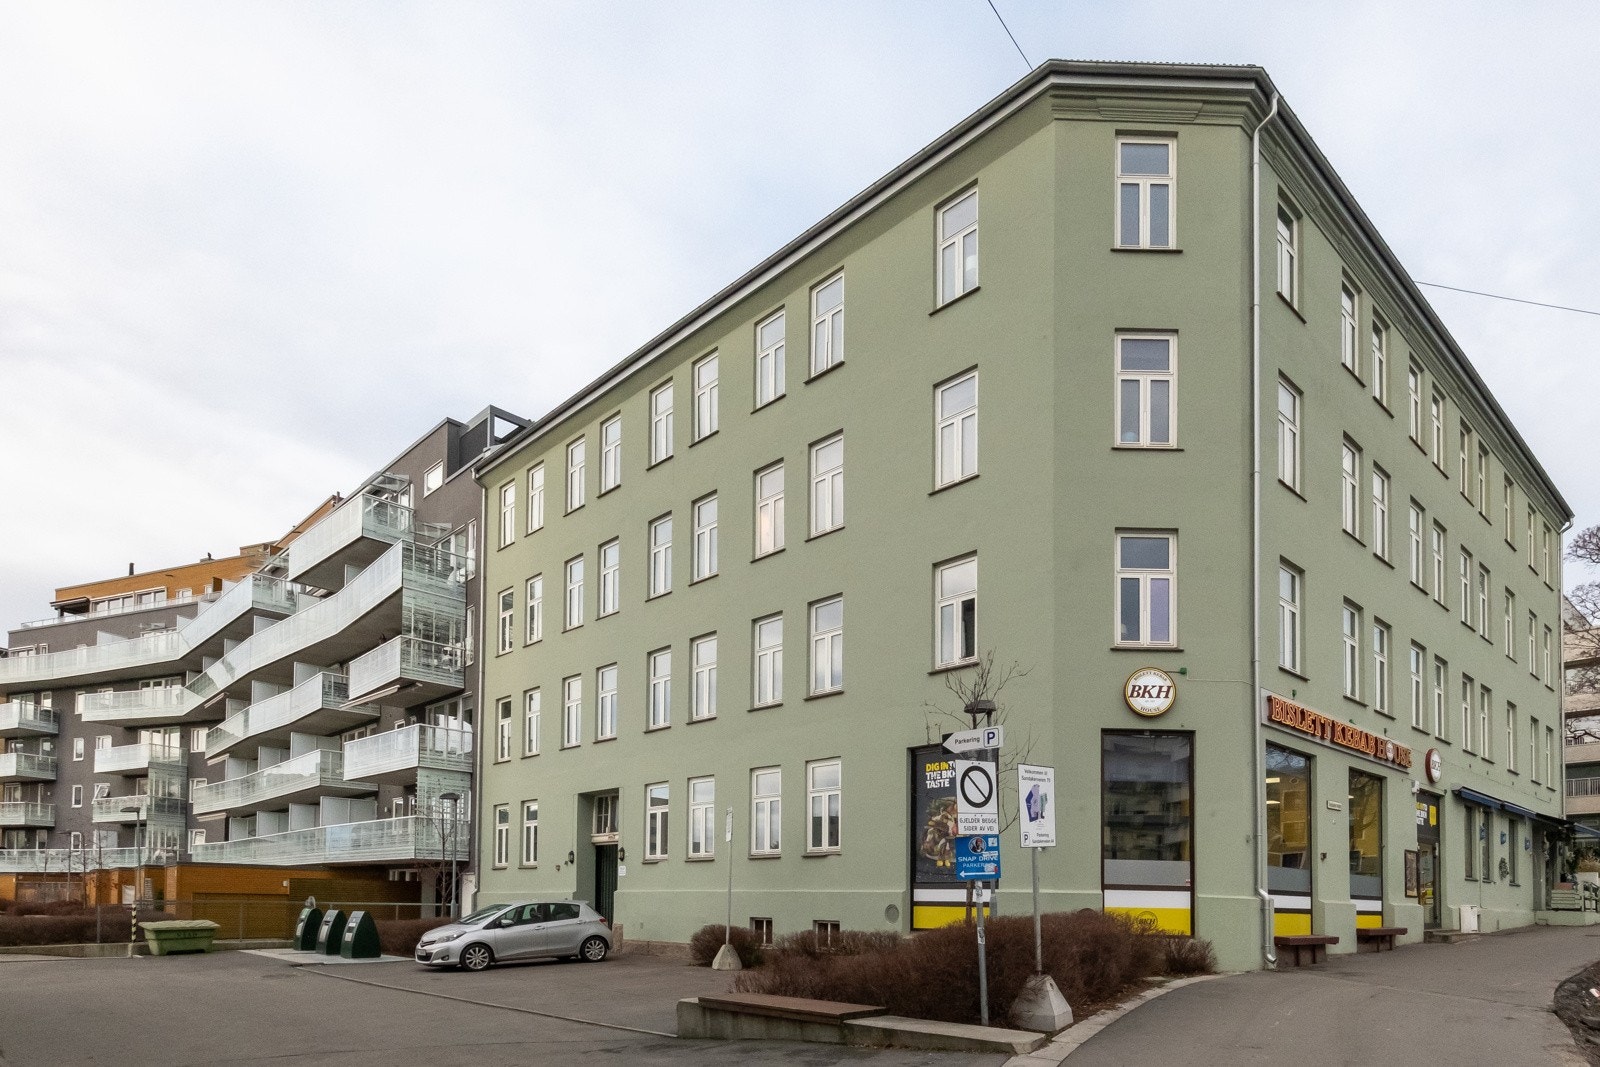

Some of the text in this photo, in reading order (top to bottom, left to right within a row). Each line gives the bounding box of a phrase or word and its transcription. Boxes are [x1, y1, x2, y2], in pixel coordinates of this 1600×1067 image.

[1129, 684, 1173, 699] BKH
[1270, 696, 1332, 739] BISLETT
[1333, 720, 1376, 755] KEBAB
[954, 731, 995, 745] Parkering P
[925, 763, 939, 772] DIG
[925, 772, 941, 780] THE
[925, 778, 950, 789] TASTE
